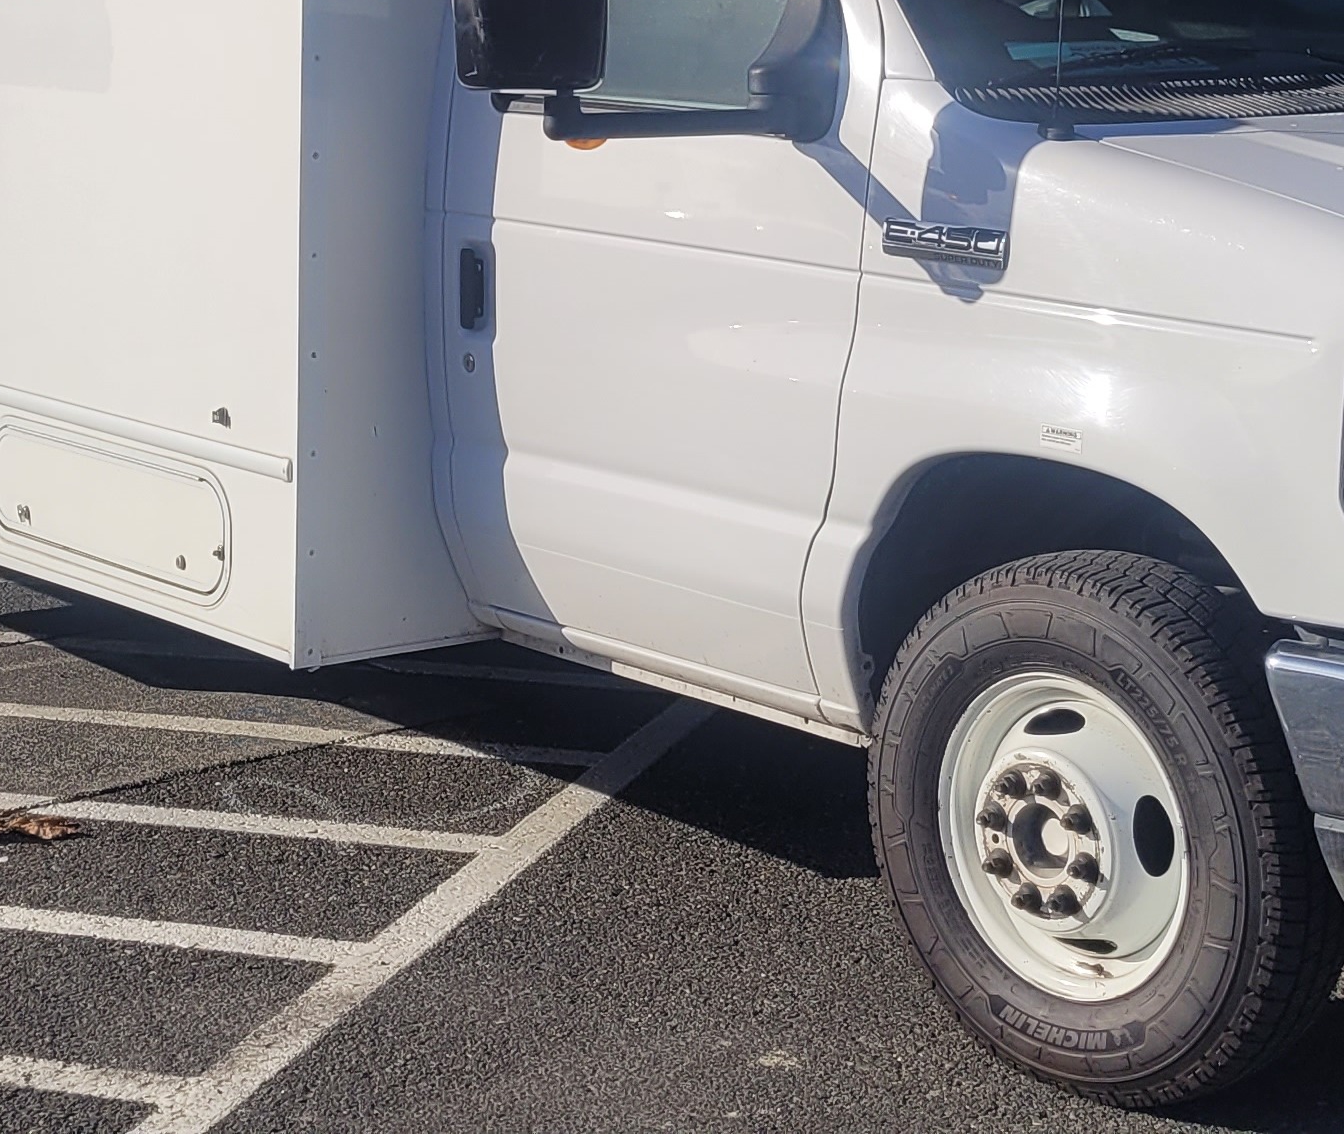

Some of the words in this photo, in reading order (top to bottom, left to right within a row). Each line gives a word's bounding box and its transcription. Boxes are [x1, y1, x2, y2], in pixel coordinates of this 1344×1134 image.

[934, 252, 969, 264] SUPER
[970, 256, 1001, 268] DUTY
[1116, 672, 1180, 748] LT225/75
[998, 1003, 1108, 1050] MICHELIN
